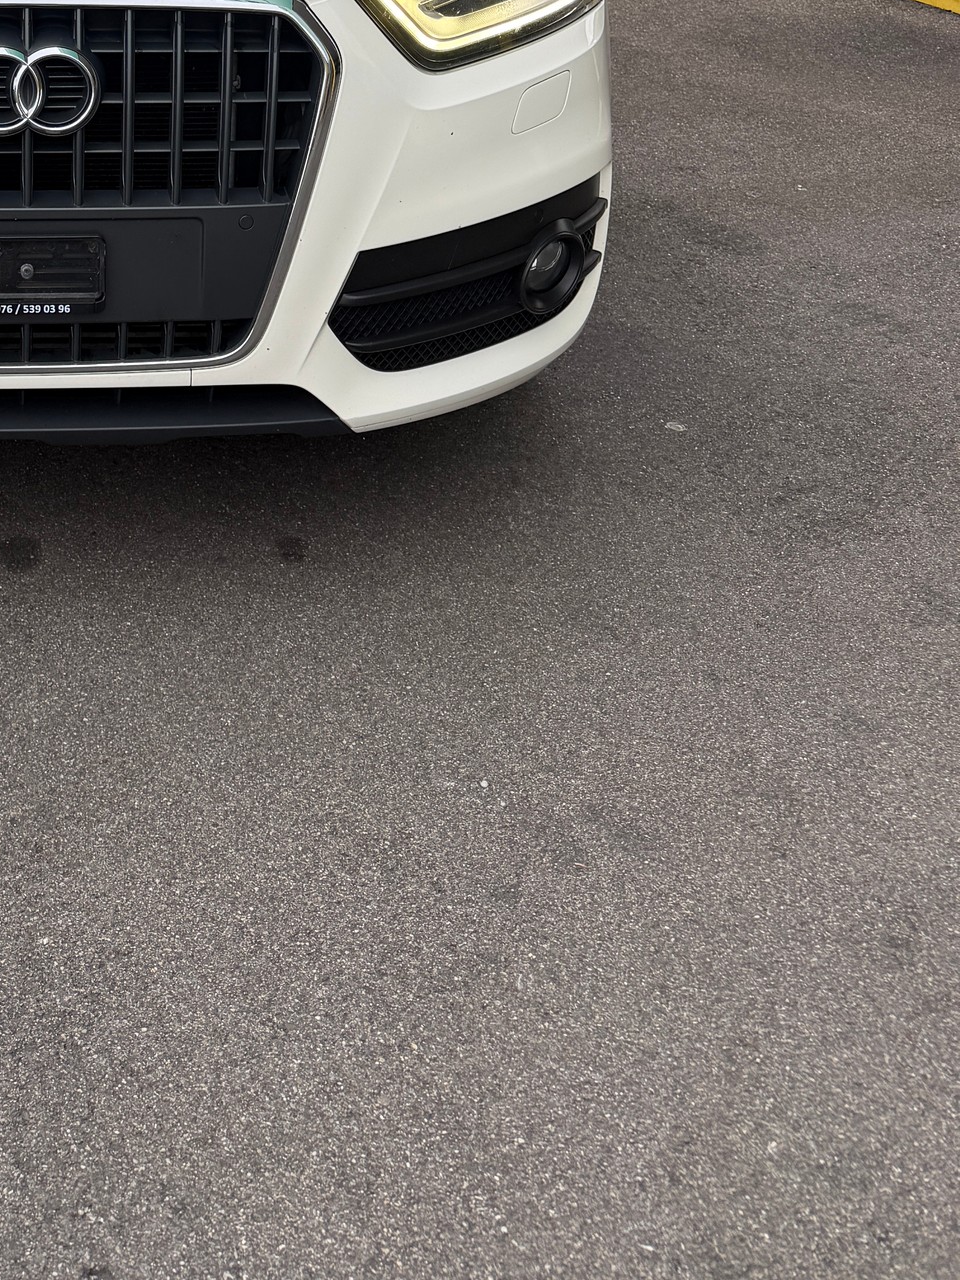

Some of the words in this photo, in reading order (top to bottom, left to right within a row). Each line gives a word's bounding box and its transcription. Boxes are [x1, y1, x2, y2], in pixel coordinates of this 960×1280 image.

[14, 304, 21, 315] /
[22, 304, 41, 314] 539
[43, 304, 56, 314] 03
[58, 304, 71, 314] 96
